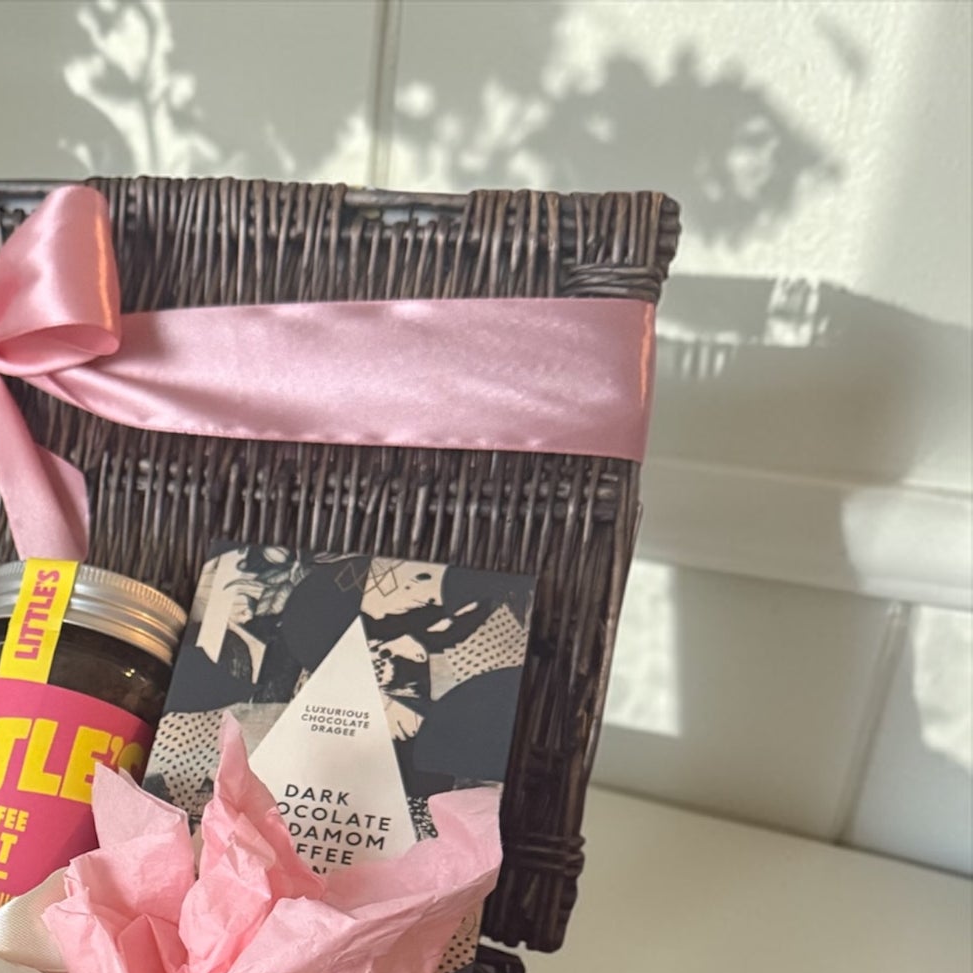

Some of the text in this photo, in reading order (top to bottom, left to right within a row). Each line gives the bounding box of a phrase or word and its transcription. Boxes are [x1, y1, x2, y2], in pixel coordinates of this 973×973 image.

[14, 569, 60, 660] LITTLE'S
[301, 713, 370, 729] CHOCOLATE
[305, 704, 370, 719] LUXURIOUS
[310, 724, 356, 737] DRAGEE
[284, 783, 350, 806] DARK
[277, 801, 392, 832] OCOLATE
[288, 822, 385, 850] DAMOM
[296, 843, 354, 865] FFEE
